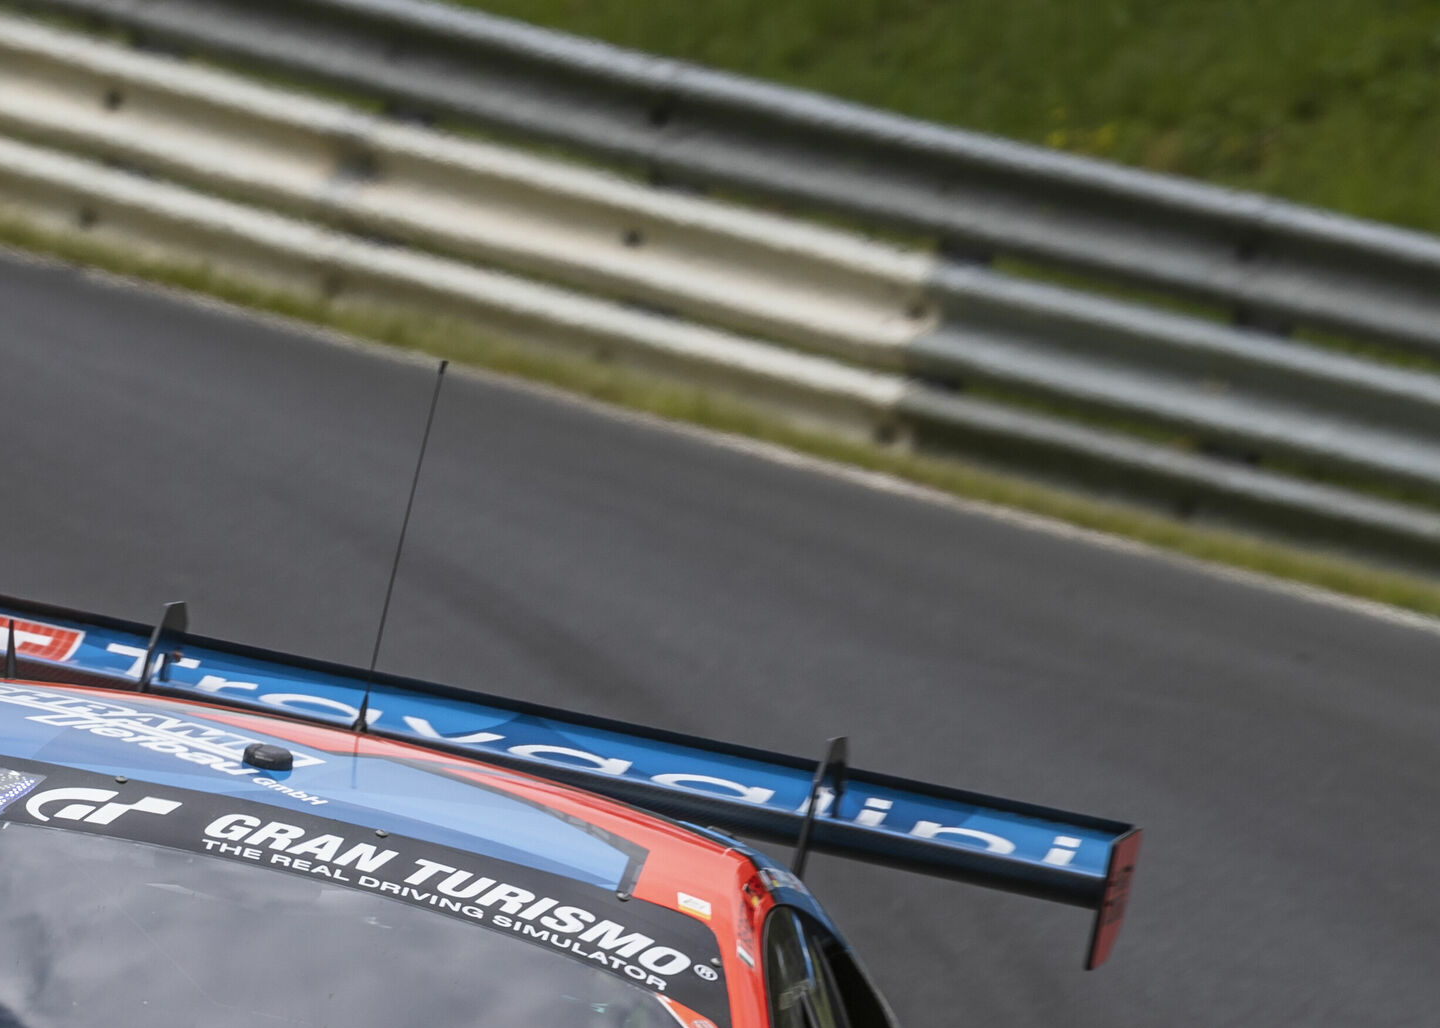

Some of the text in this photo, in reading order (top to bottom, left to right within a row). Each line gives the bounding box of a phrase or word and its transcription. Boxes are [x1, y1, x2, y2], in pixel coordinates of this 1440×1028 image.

[203, 813, 399, 873] GRAN
[202, 838, 668, 992] THE REAL DRIVING SIMULATOR
